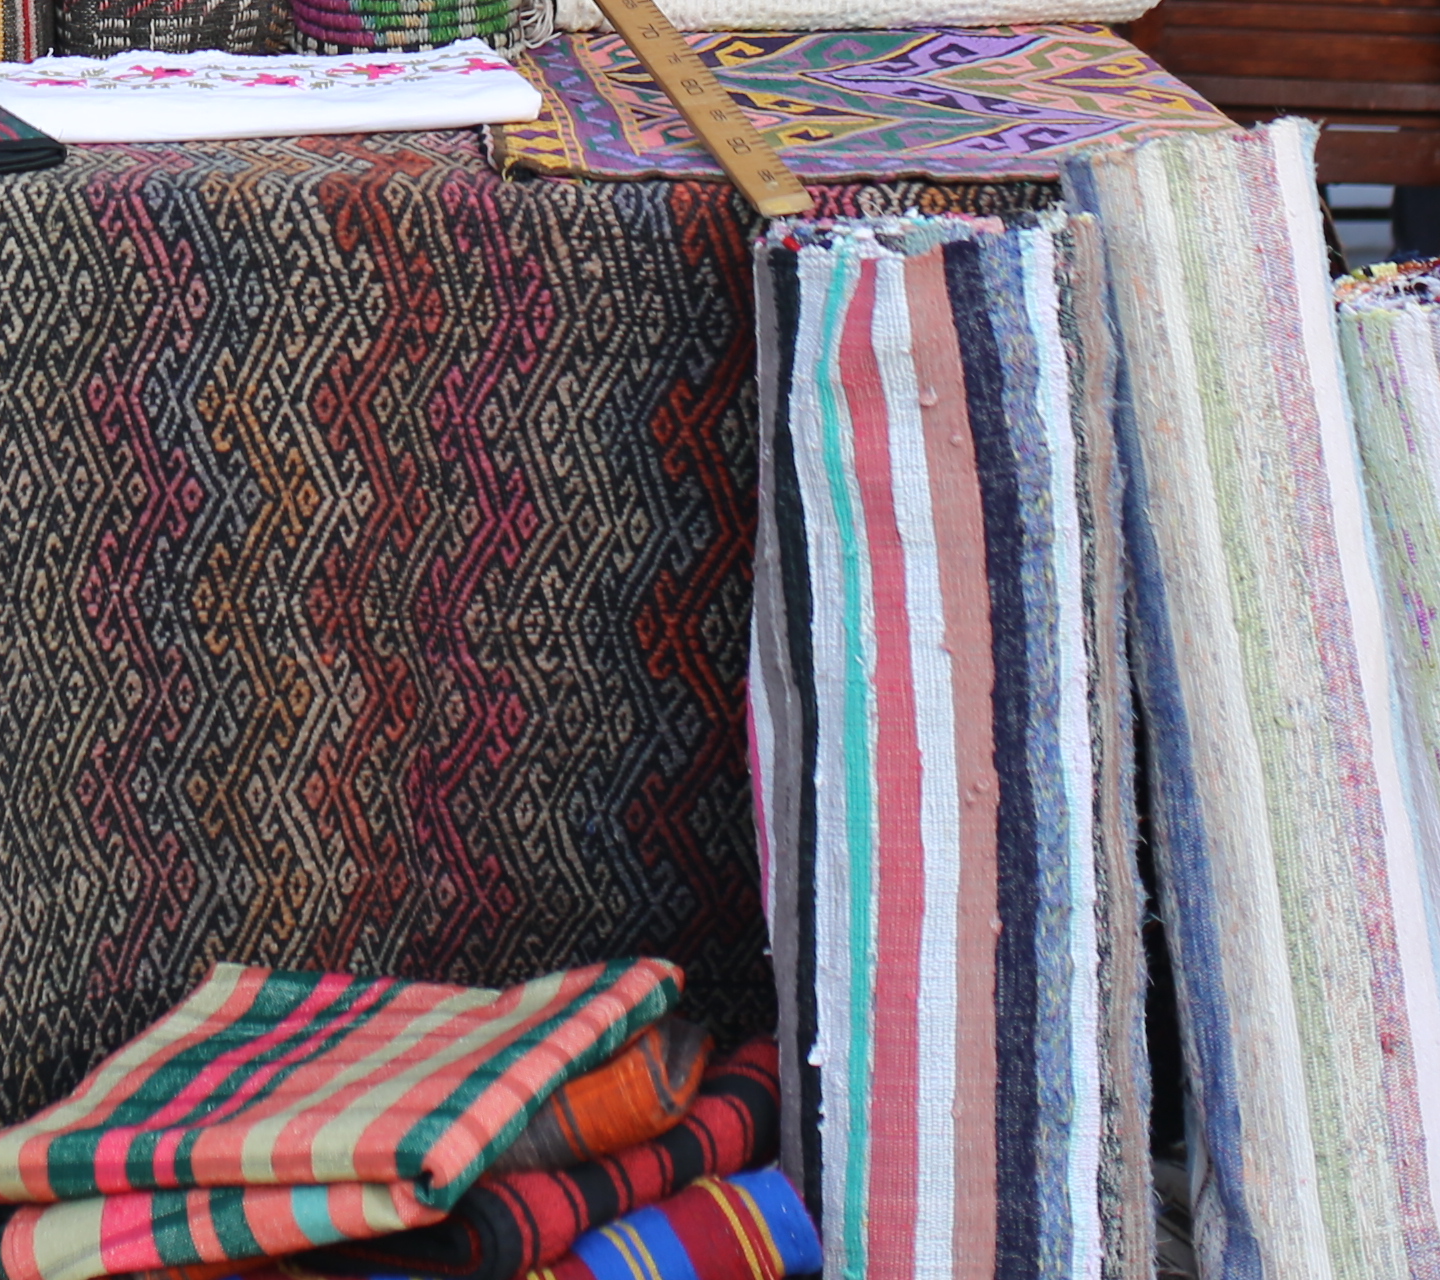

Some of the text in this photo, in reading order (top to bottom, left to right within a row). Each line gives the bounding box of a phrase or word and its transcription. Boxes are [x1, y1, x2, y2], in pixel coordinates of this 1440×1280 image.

[637, 23, 660, 39] 70
[680, 78, 704, 96] 80
[726, 136, 752, 155] 90
